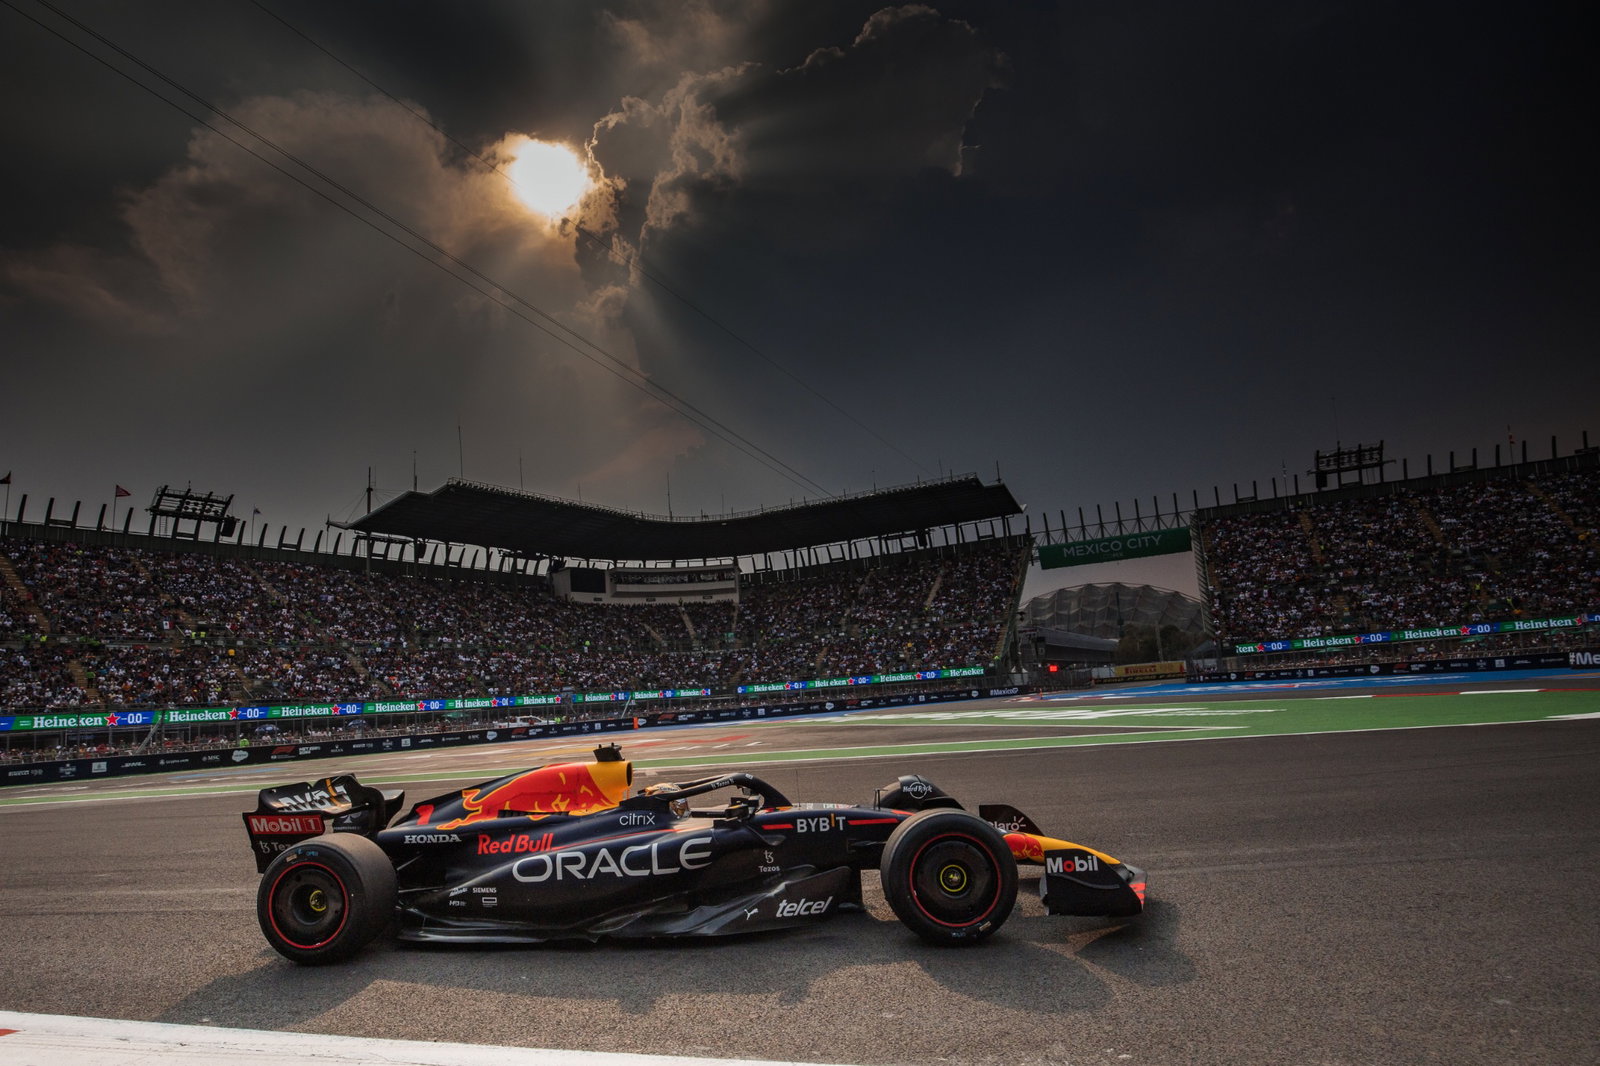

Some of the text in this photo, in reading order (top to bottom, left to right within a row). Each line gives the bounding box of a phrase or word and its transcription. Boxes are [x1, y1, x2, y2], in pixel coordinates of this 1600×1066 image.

[1063, 535, 1162, 557] MEXICO CITY
[1515, 617, 1573, 630] Heineken
[1405, 627, 1457, 640] Heineken
[375, 701, 415, 712] Heineken
[523, 695, 554, 705] Heinekn
[169, 709, 226, 722] Heineken
[281, 706, 329, 717] Heineken
[33, 715, 103, 729] Heineken
[252, 817, 317, 834] Mobil 1
[619, 812, 656, 826] citrix
[797, 813, 846, 833] BYBIT
[404, 834, 461, 844] HONDA
[478, 833, 553, 855] Red Bull
[512, 836, 713, 883] ORACLE
[1047, 856, 1099, 874] Mobil
[758, 865, 780, 873] Tezos
[776, 897, 833, 918] telcel
